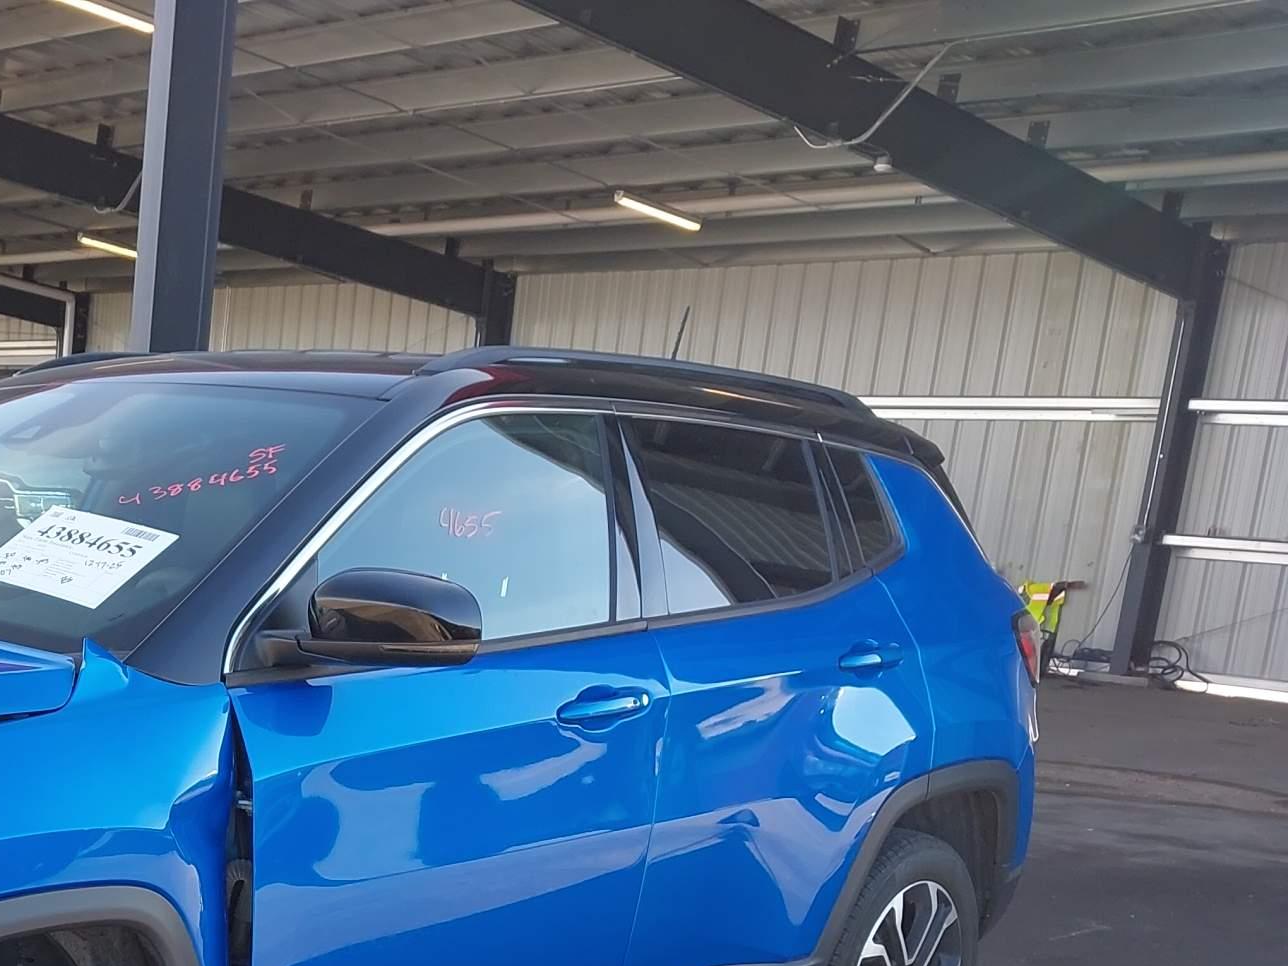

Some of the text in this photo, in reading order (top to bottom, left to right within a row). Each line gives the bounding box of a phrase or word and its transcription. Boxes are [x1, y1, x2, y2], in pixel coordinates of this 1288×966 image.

[118, 459, 278, 505] 43884655
[439, 506, 502, 537] 4655
[37, 524, 143, 558] 43884655
